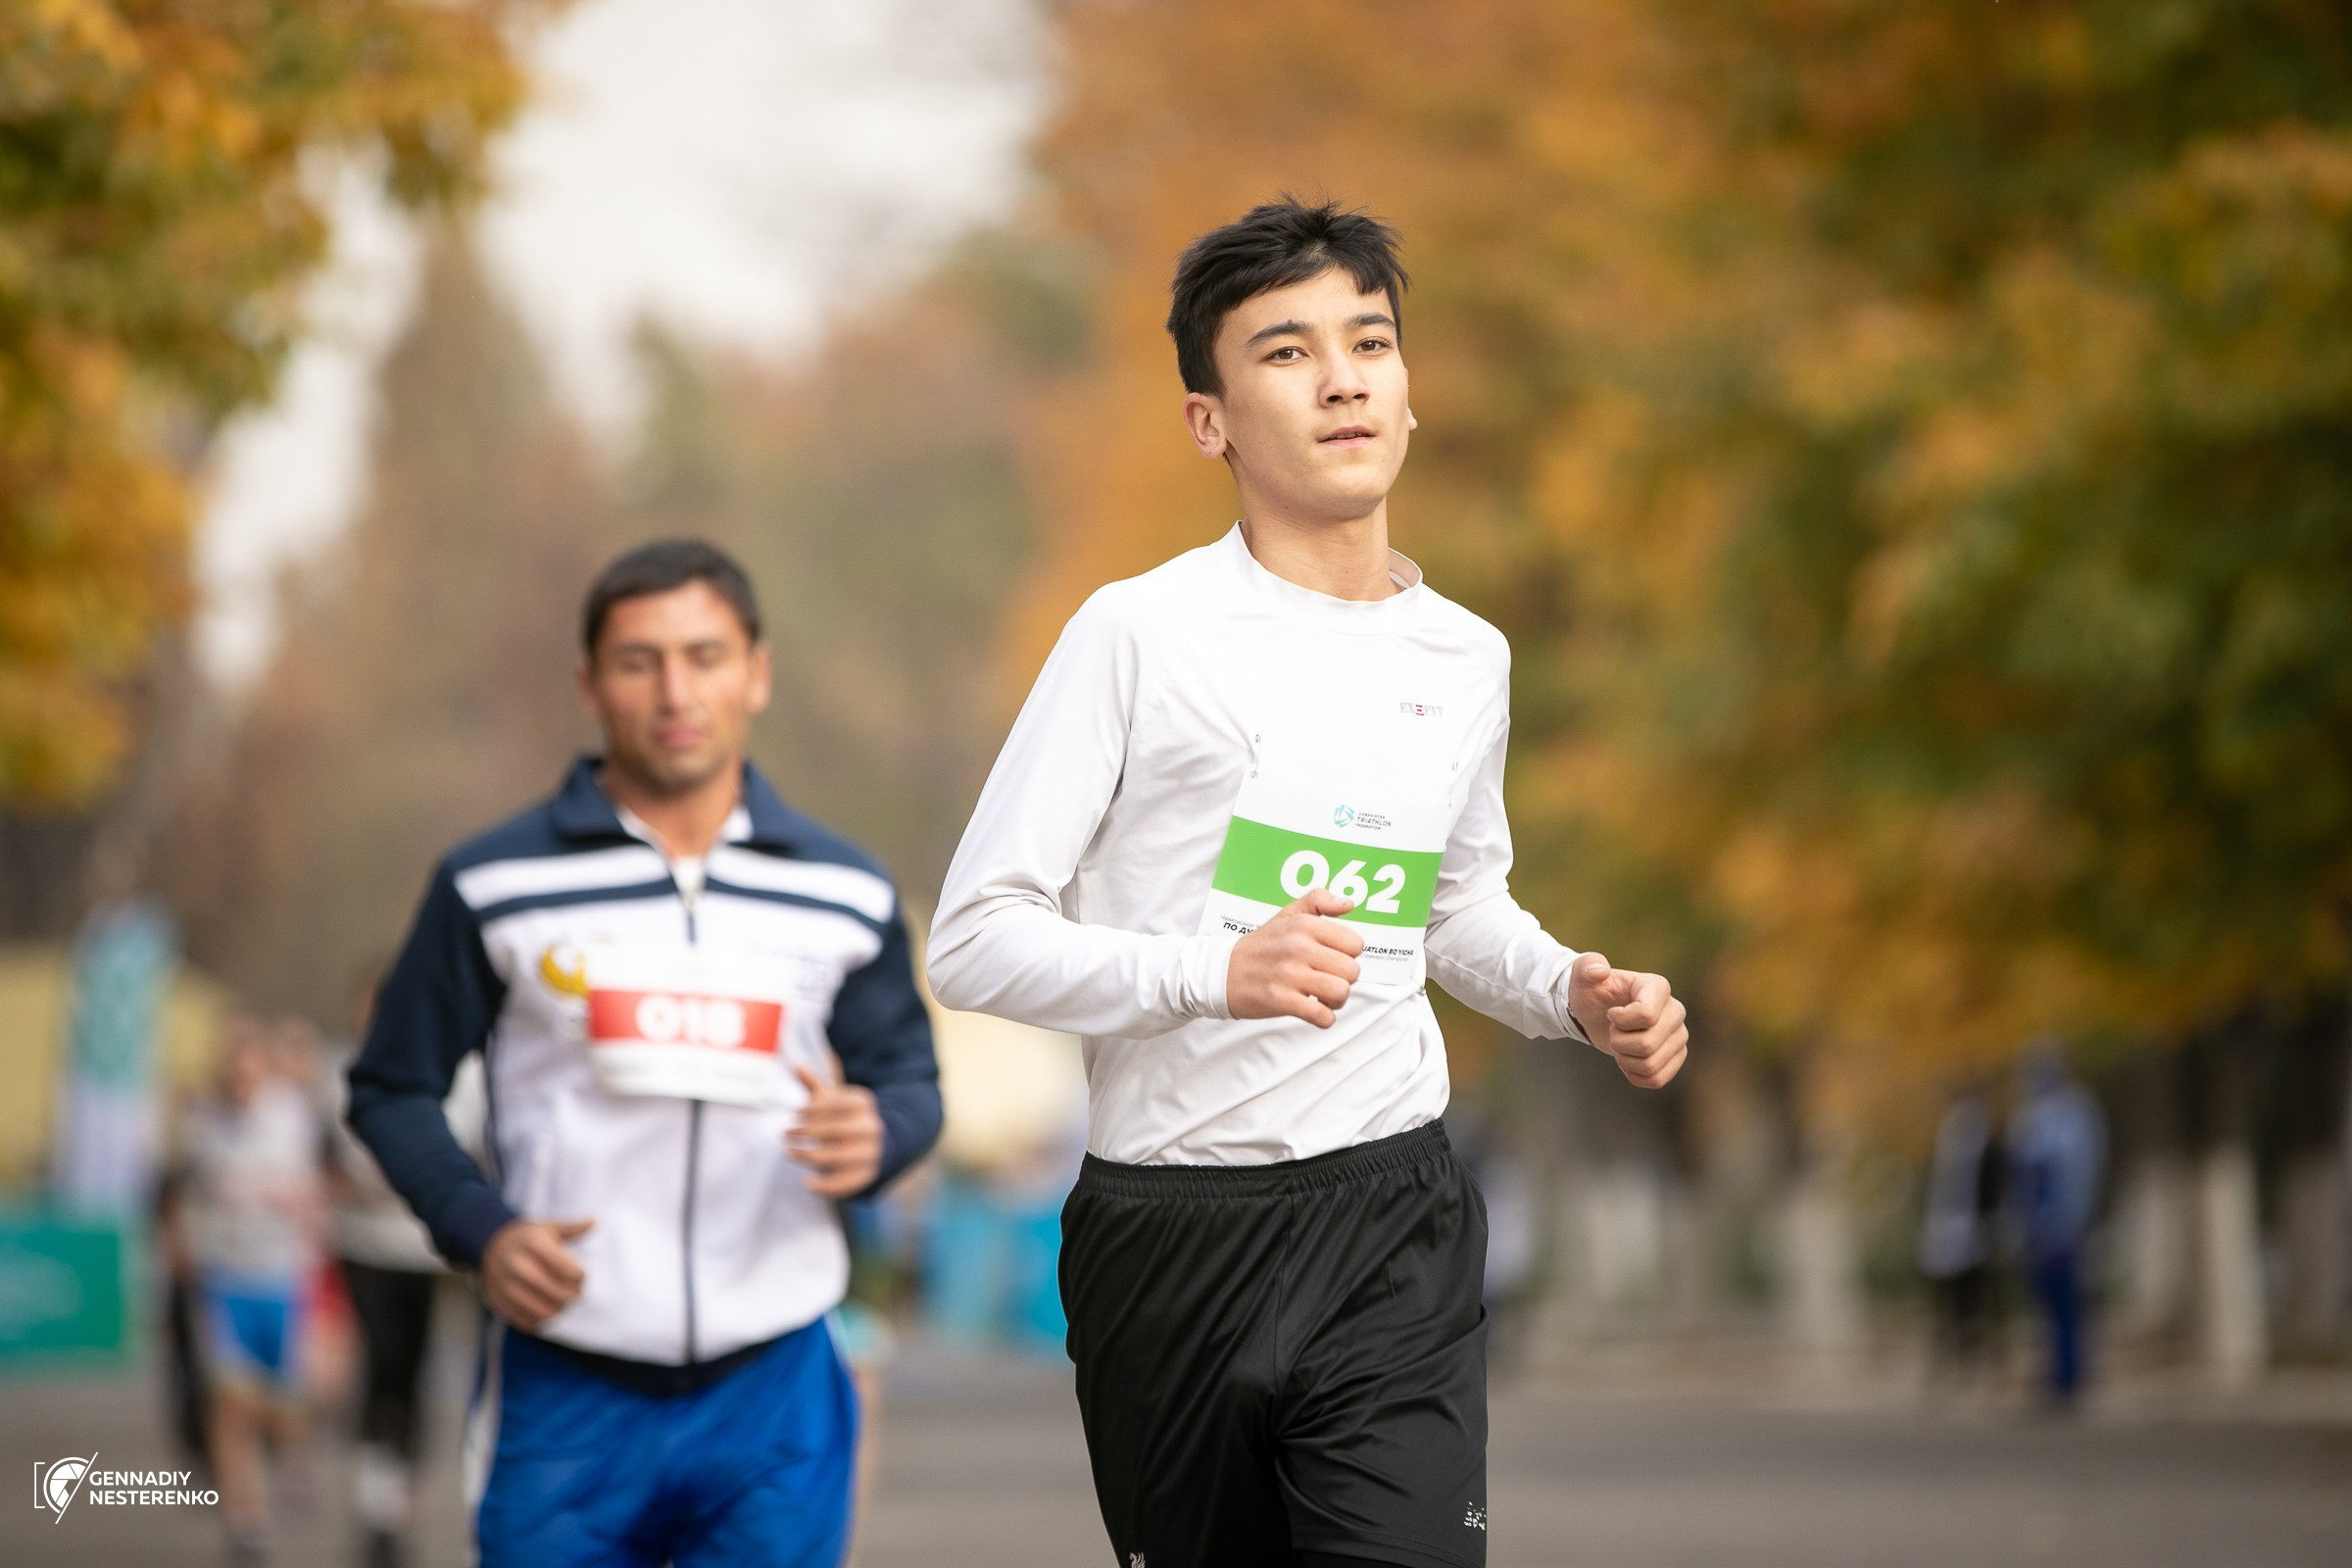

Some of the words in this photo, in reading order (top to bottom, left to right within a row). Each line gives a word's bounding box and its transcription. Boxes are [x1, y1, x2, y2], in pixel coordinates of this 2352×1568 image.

[1357, 816, 1392, 827] TRIATHLON
[1280, 850, 1405, 914] 062
[1223, 922, 1238, 931] ПО
